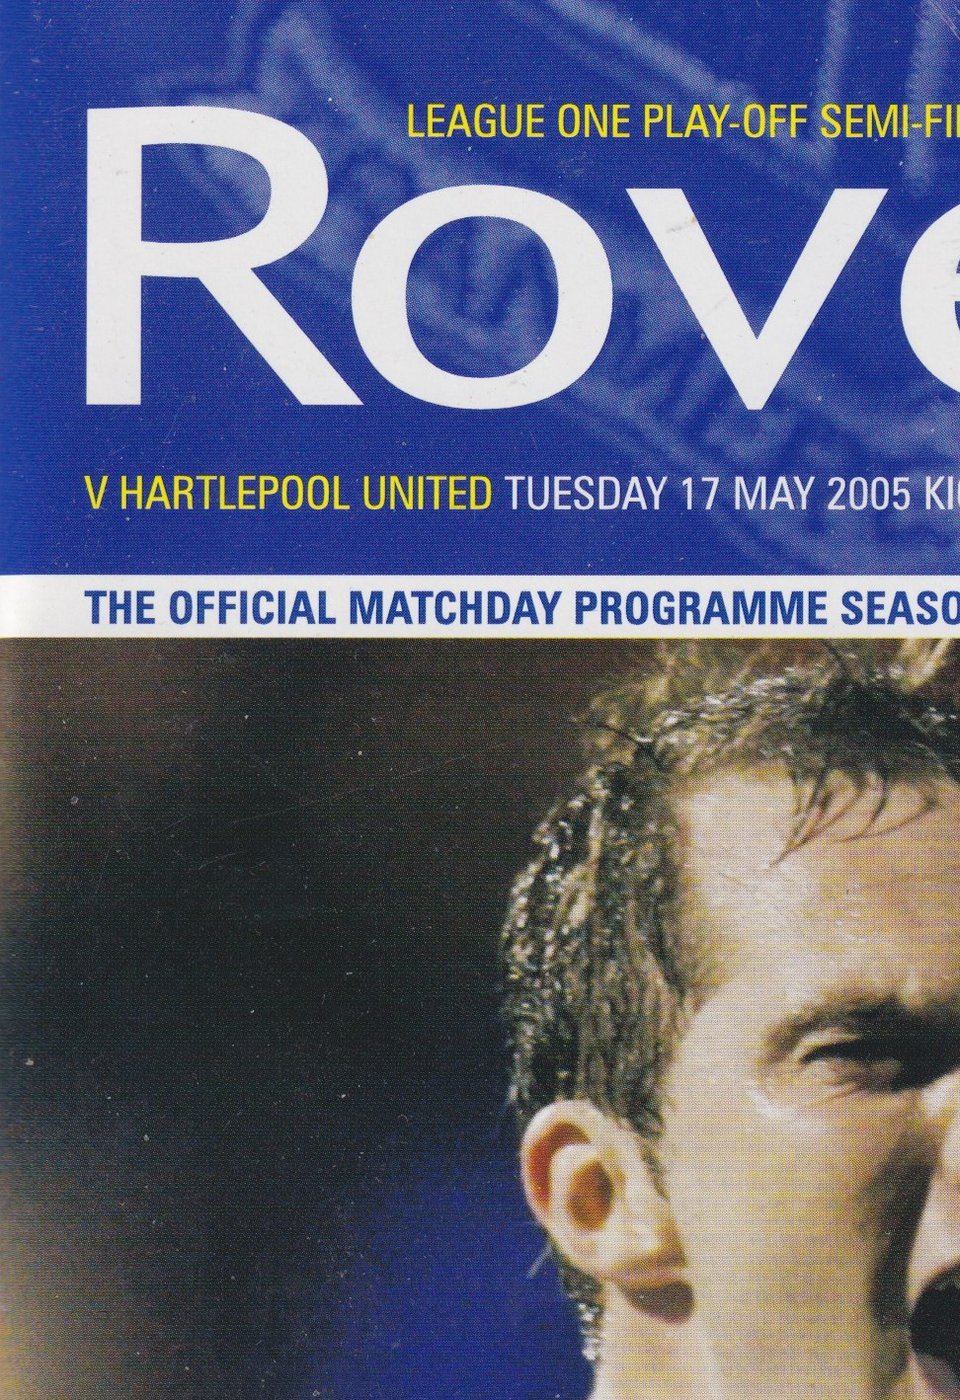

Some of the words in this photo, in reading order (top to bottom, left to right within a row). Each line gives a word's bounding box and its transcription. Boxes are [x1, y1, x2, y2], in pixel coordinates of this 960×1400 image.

[409, 104, 542, 138] LEAGUE
[558, 104, 629, 138] ONE
[645, 104, 807, 138] PLAY-OFF
[85, 476, 108, 509] V
[121, 476, 350, 510] HARTLEPOOL
[363, 476, 491, 510] UNITED
[504, 476, 668, 510] TUESDAY
[683, 476, 720, 510] 17
[734, 476, 816, 510] MAY
[827, 476, 911, 510] 2005
[85, 591, 156, 625] THE
[169, 591, 337, 625] OFFICIAL
[350, 591, 562, 625] MATCHDAY
[575, 591, 828, 625] PROGRAMME
